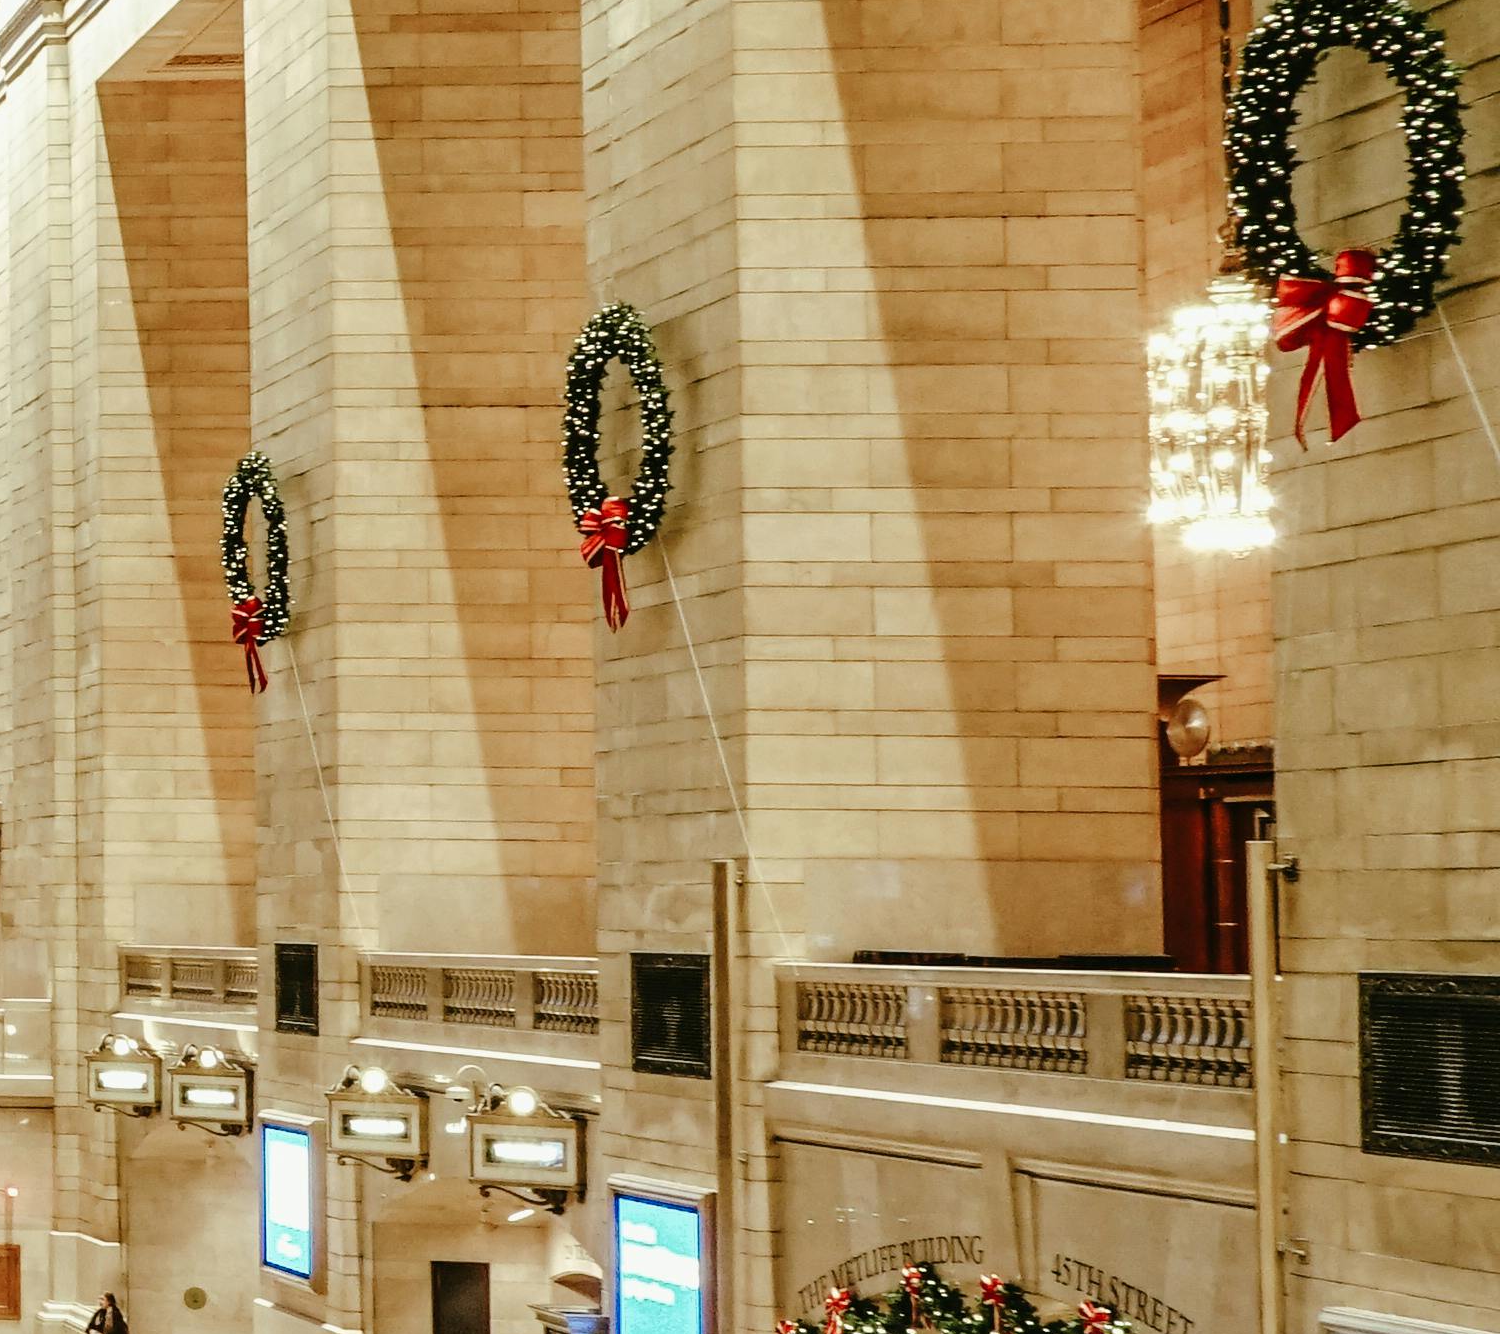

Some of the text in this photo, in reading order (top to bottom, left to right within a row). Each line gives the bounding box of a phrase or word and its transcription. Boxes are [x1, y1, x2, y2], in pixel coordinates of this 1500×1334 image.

[830, 1241, 898, 1287] METLIFE
[902, 1234, 985, 1267] BUILDING
[1051, 1252, 1104, 1297] 45TH
